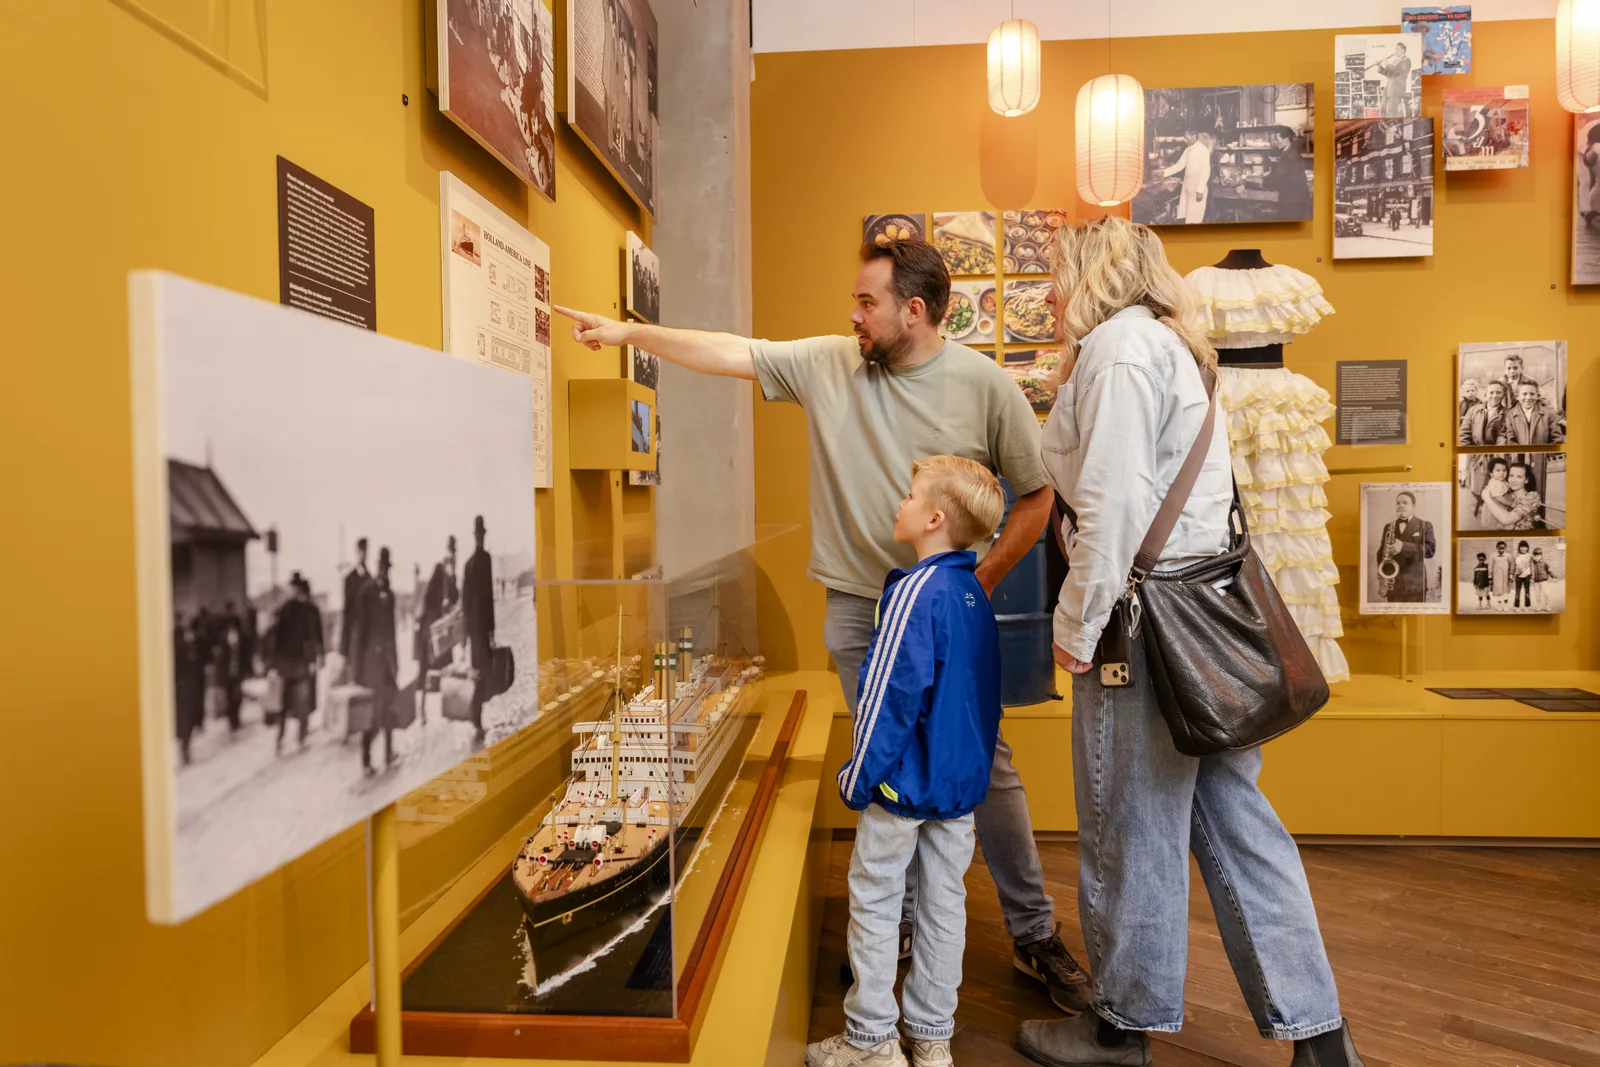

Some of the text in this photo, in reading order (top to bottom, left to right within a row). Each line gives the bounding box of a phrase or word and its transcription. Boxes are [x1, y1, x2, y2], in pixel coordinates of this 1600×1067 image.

[1467, 105, 1485, 140] 3
[483, 230, 532, 269] HOLLAND-AMERICA LINE
